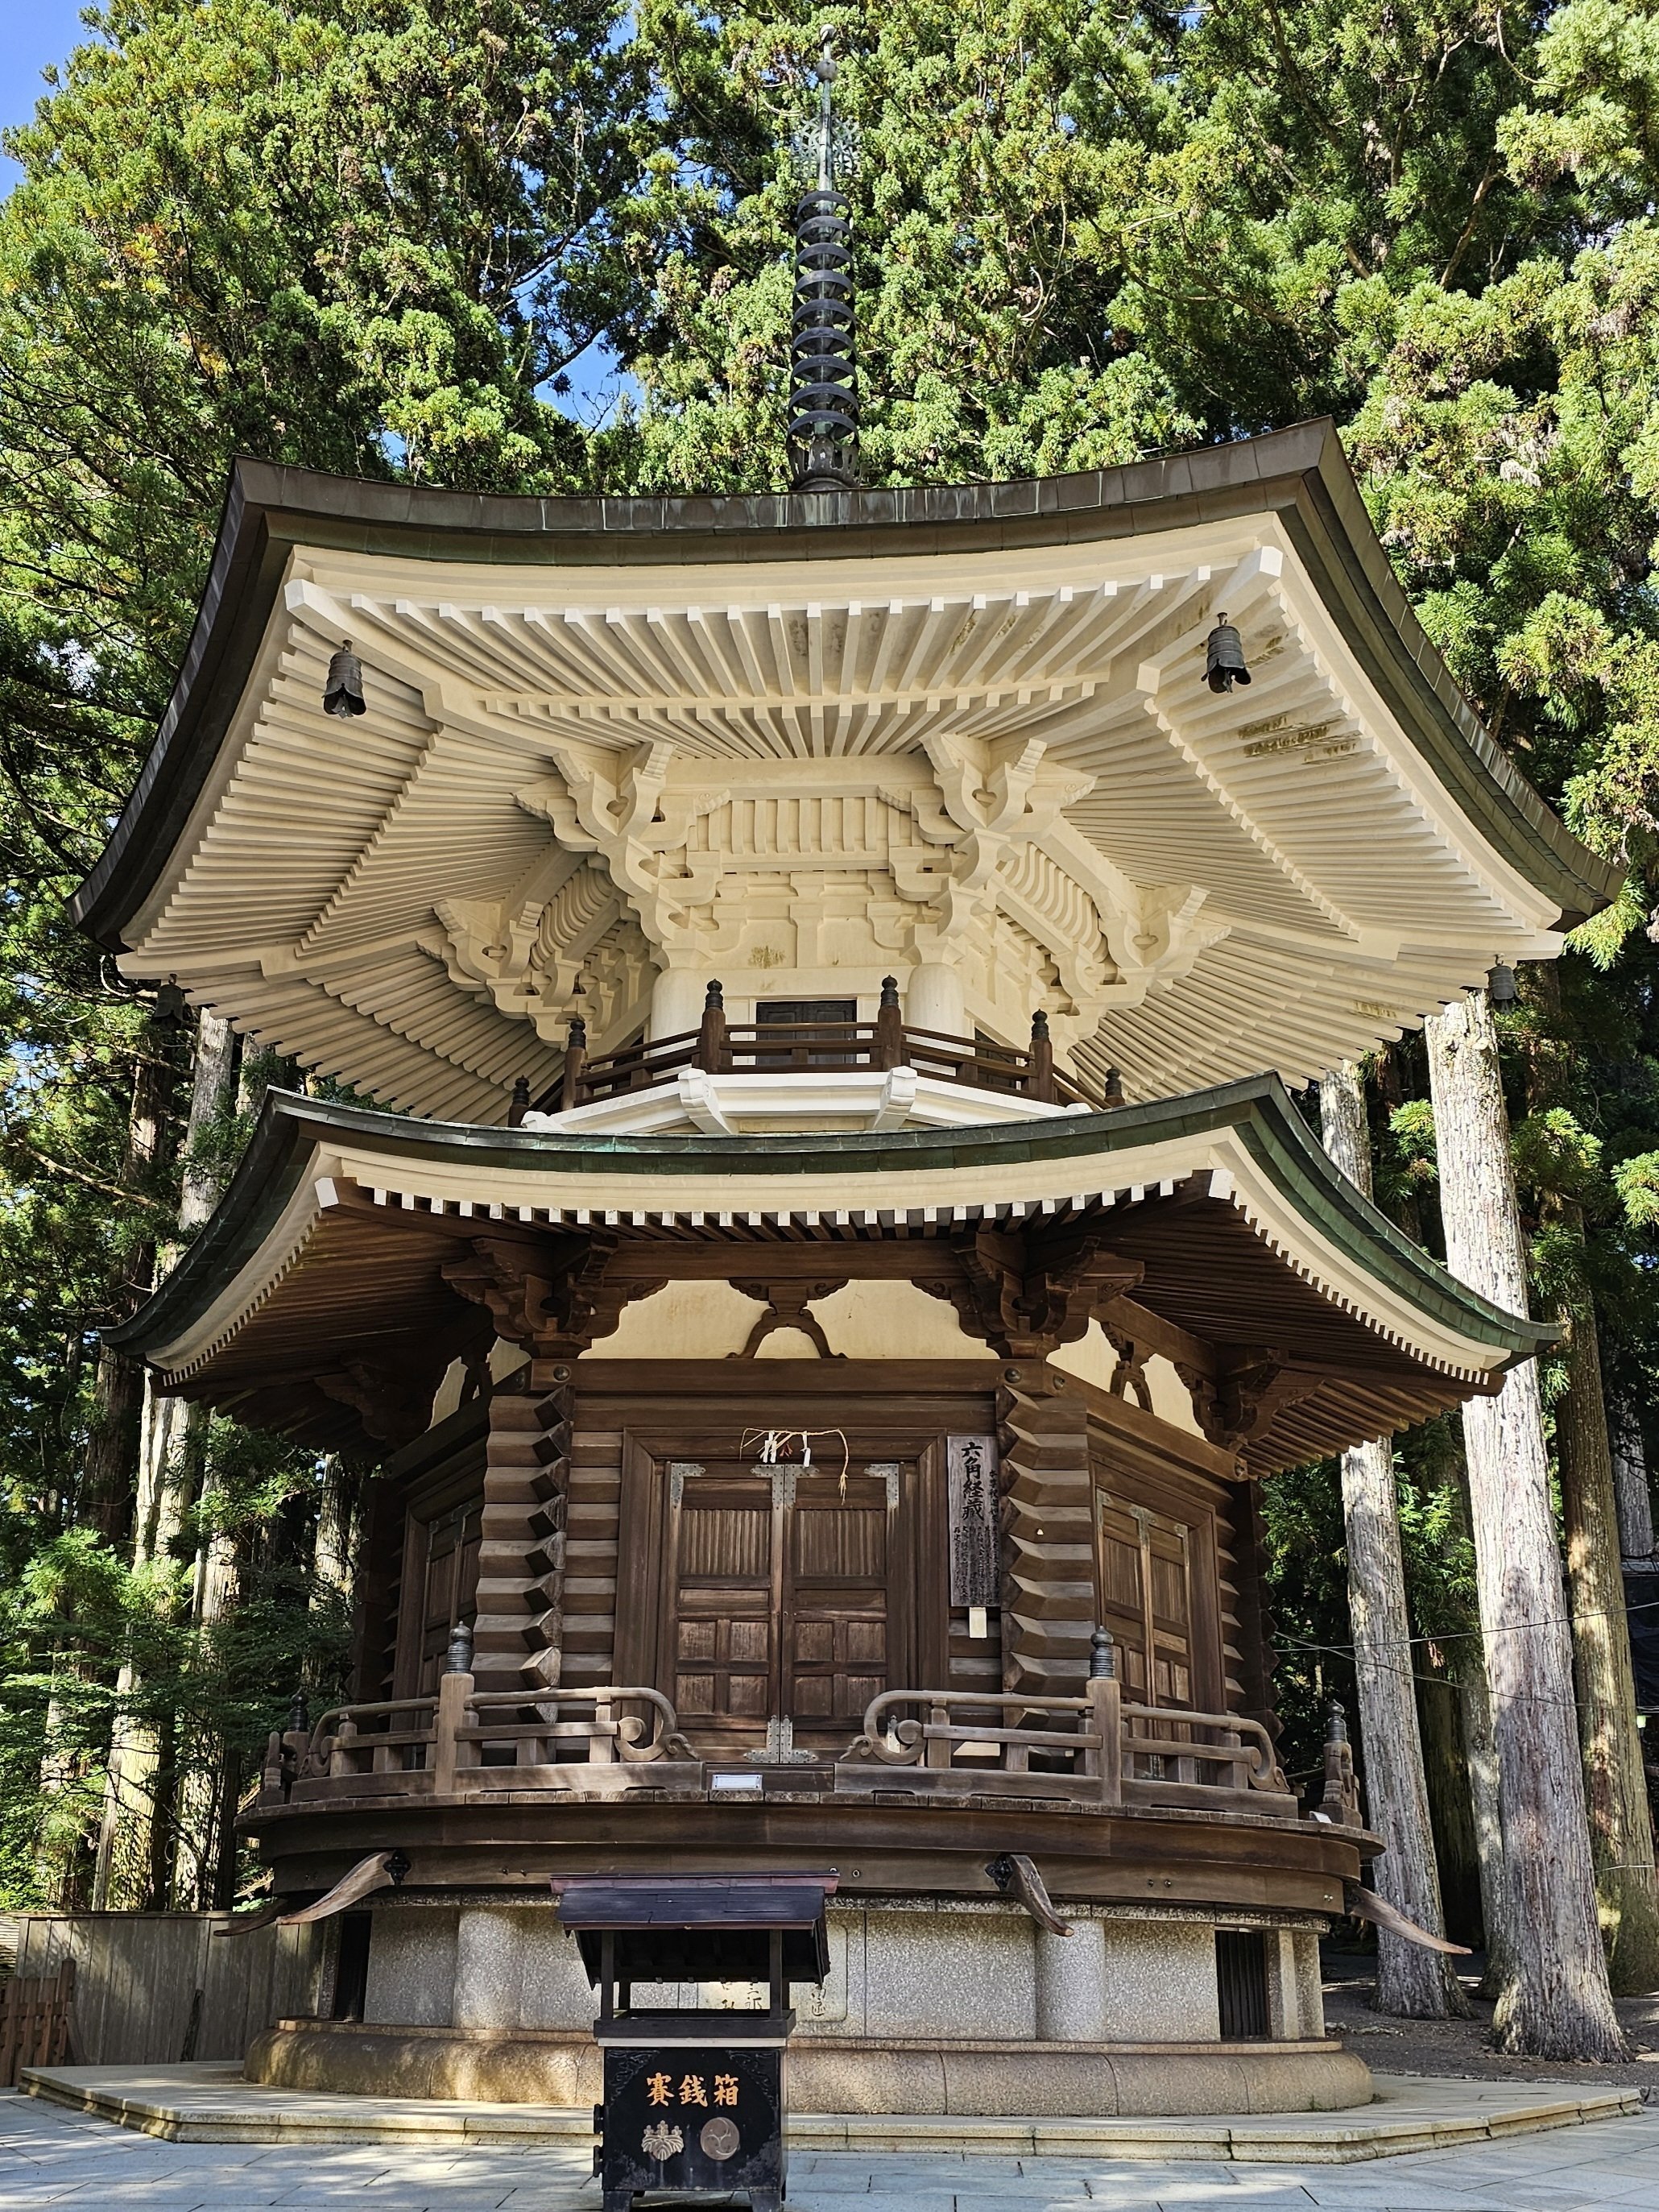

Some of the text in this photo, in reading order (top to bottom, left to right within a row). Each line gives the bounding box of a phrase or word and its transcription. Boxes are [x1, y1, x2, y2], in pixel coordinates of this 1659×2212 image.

[961, 1441, 984, 1521] 六角経蔵
[646, 2072, 739, 2107] 賽銭箱
